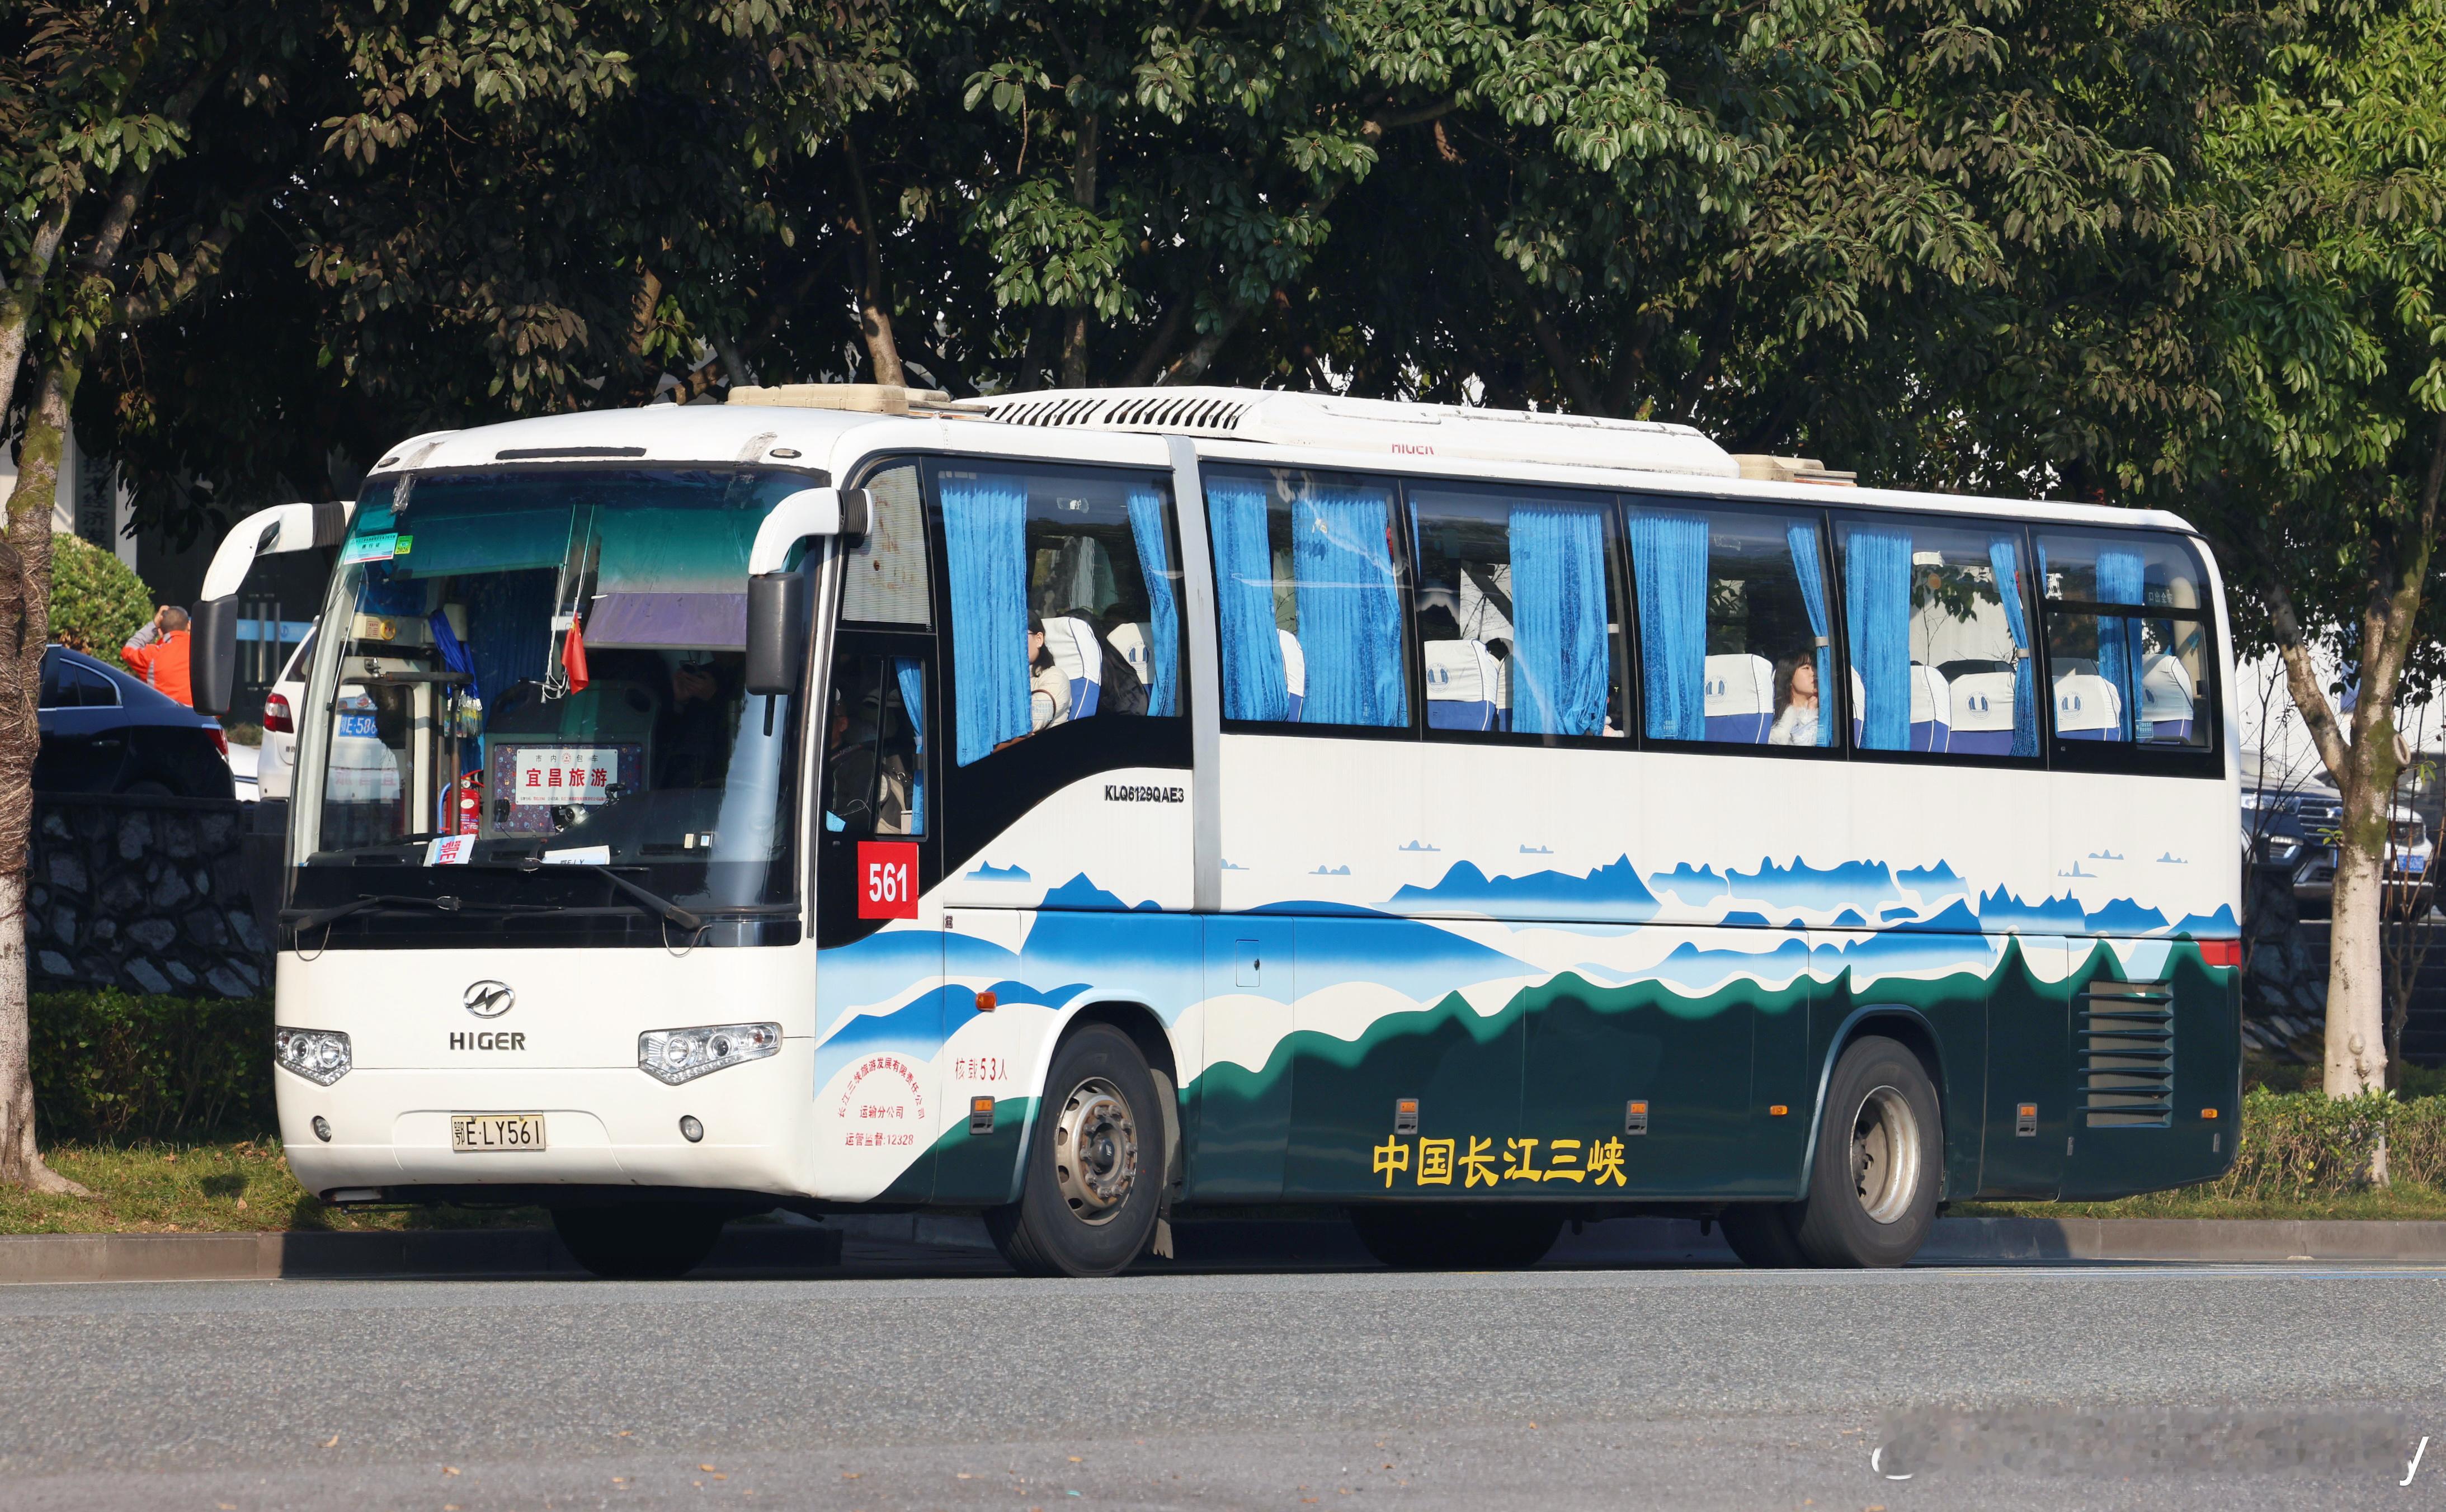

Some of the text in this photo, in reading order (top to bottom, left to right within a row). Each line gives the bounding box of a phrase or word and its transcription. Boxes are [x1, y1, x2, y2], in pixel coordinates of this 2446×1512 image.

[525, 768, 607, 787] 宜昌旅游
[1104, 785, 1185, 803] KLQ6129QAE3
[869, 862, 907, 902] 561
[450, 1031, 526, 1051] HIGER
[837, 1056, 926, 1120] 长江三峡旅游发展有限责任公司
[859, 1105, 904, 1119] 运输分公司
[454, 1120, 540, 1146] 鄂E·LY561
[1373, 1134, 1628, 1189] 中国长江三峡
